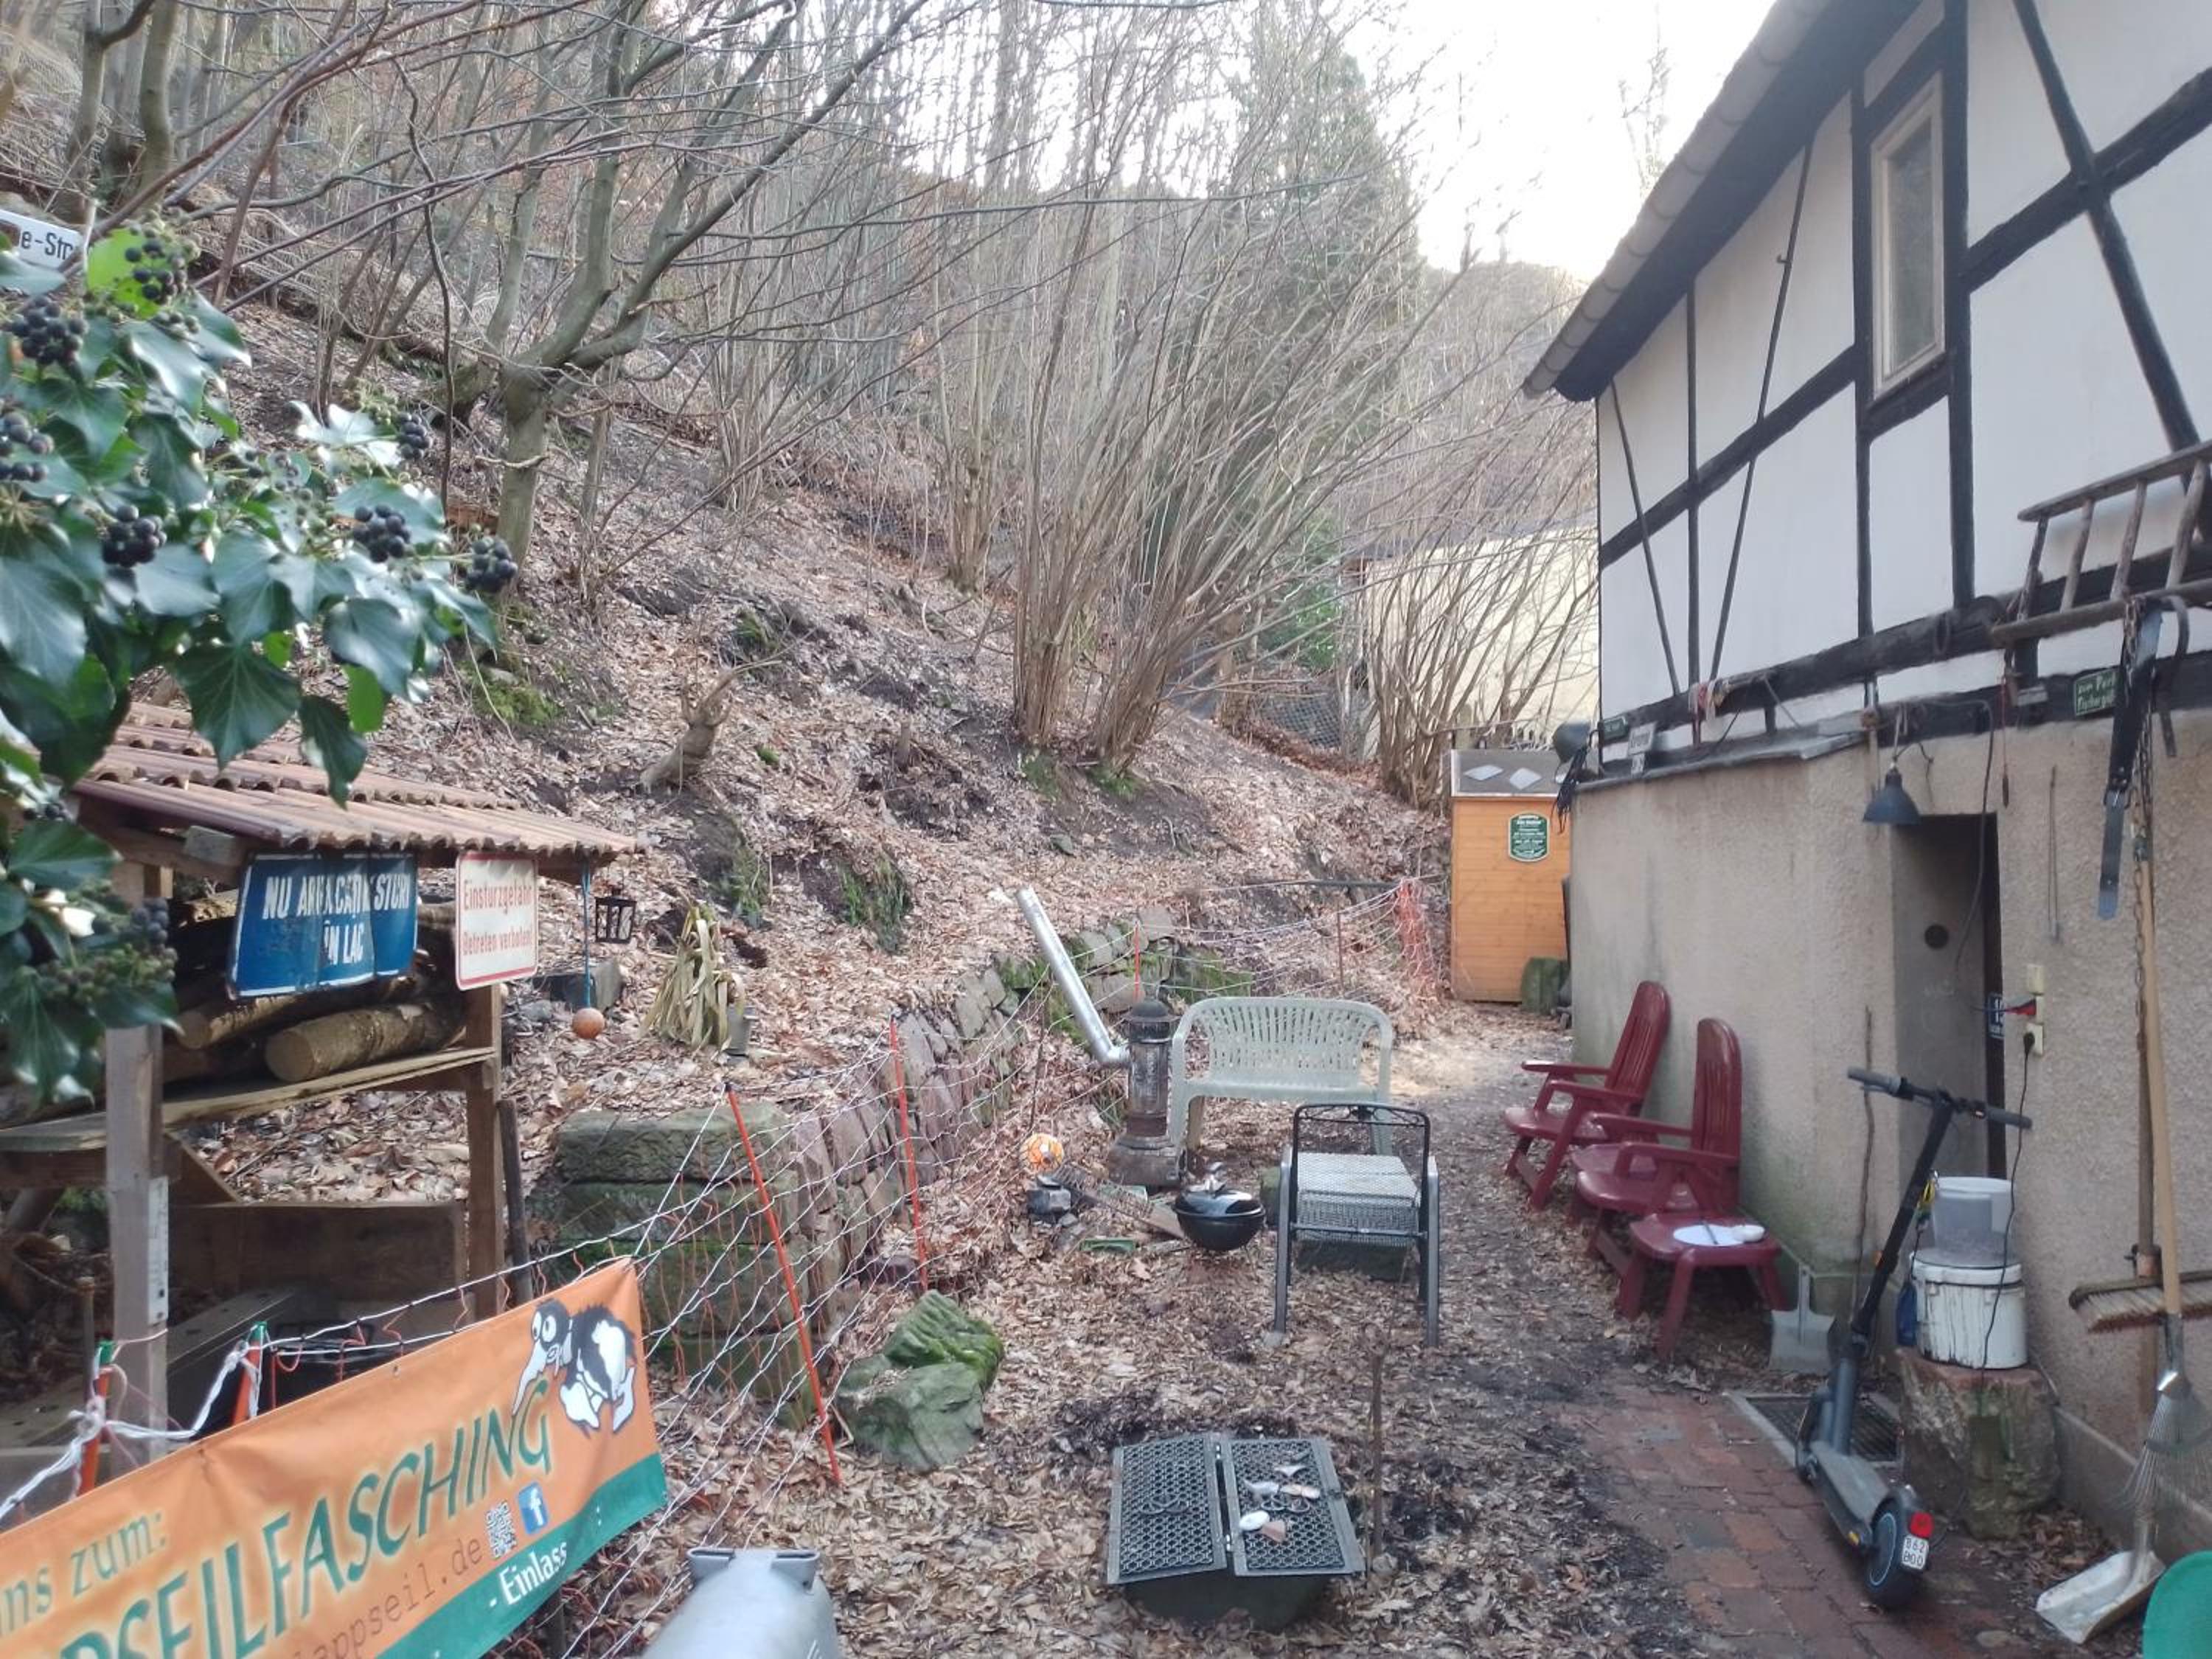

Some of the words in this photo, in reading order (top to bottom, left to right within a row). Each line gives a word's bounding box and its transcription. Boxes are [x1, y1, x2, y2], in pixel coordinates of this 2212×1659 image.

[21, 230, 74, 260] e-Str
[261, 876, 293, 920] NU
[343, 922, 365, 964] LAC
[0, 1568, 52, 1635] ns
[71, 1512, 167, 1596] zum:
[293, 1537, 482, 1659] appseil.de
[498, 1540, 568, 1606] Einlass
